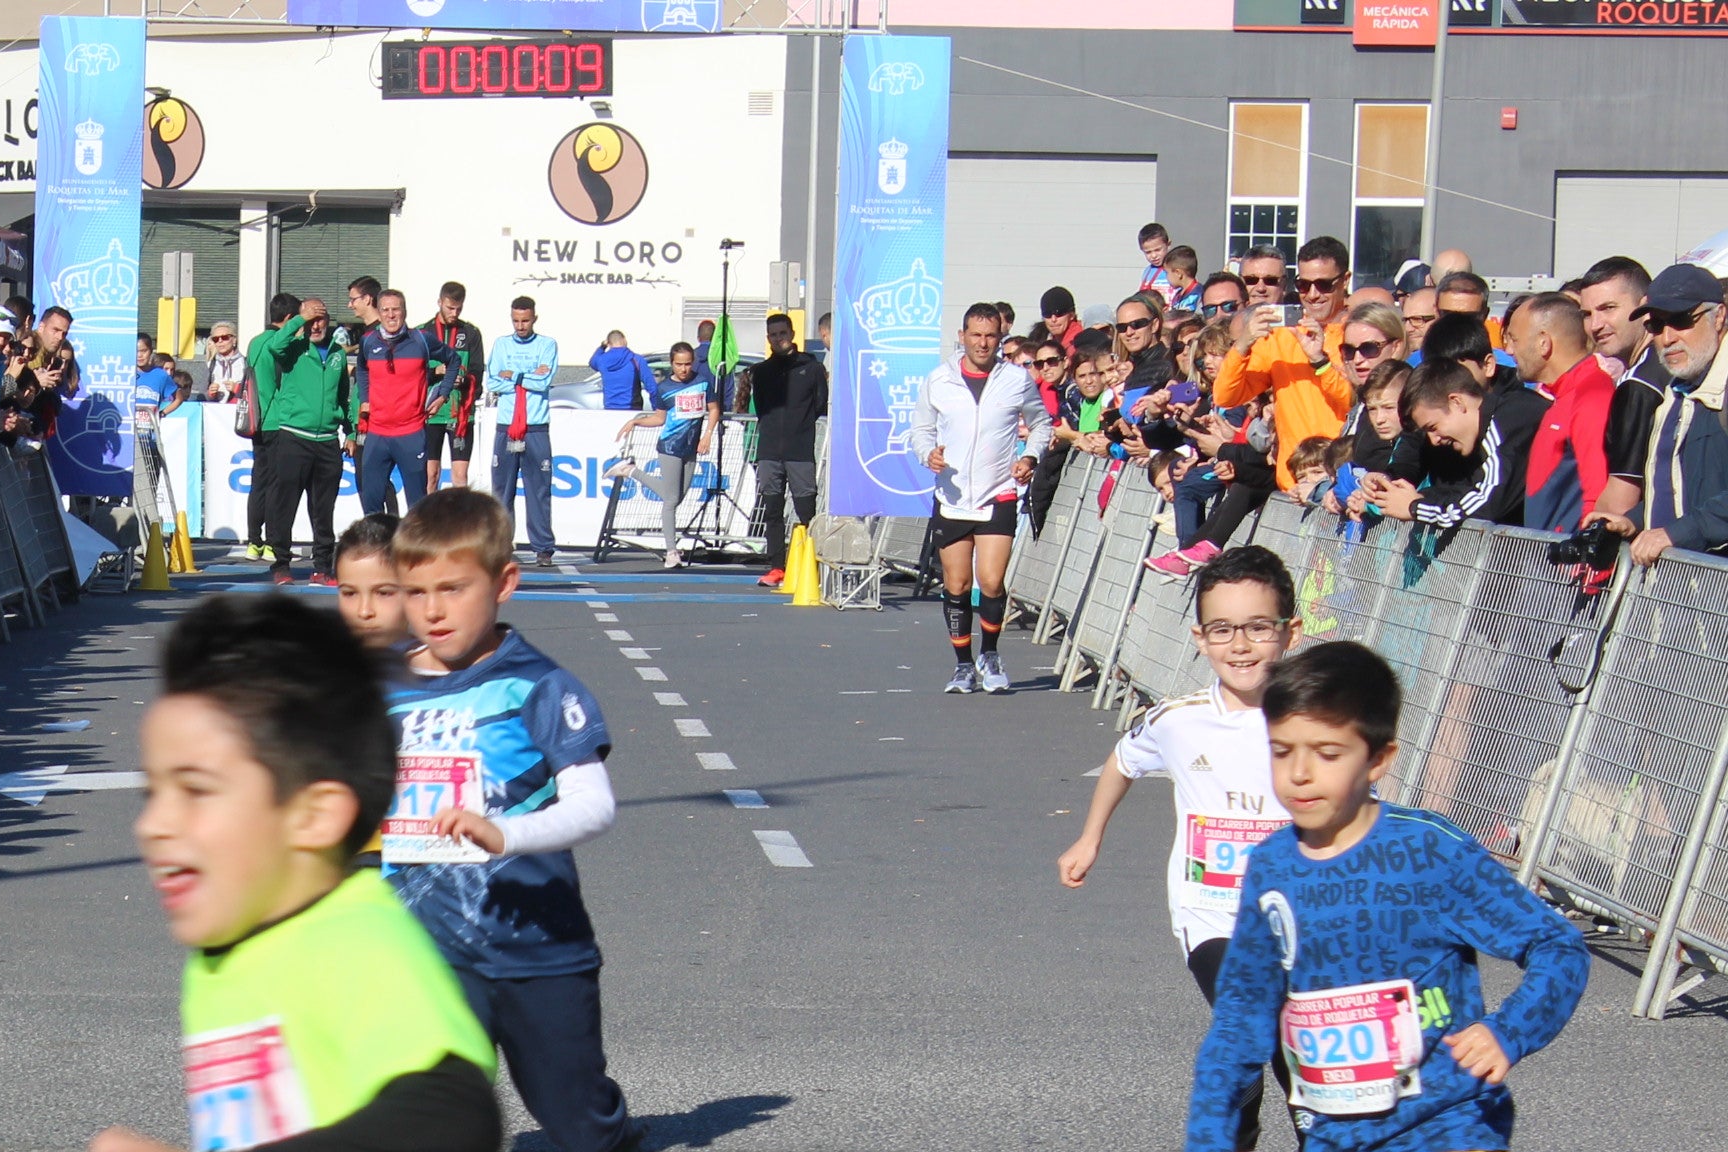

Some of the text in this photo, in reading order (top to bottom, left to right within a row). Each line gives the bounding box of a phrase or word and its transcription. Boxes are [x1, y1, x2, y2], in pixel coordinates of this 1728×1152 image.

[1363, 6, 1429, 17] MECÁNICA
[1372, 18, 1419, 29] RÁPIDA
[4, 98, 38, 146] LO
[17, 160, 37, 181] BA
[512, 239, 683, 267] NEW LORO
[559, 273, 633, 284] SNACK BAR
[1226, 791, 1264, 815] Fly
[1217, 820, 1254, 829] CARRERA
[1204, 829, 1232, 839] CIUDAD
[1234, 831, 1244, 840] DE
[1295, 881, 1368, 910] HARDER
[1333, 993, 1379, 1009] POPULAR
[1310, 1014, 1322, 1025] DE
[1324, 1007, 1377, 1023] ROQUETAS
[1299, 1024, 1375, 1064] 920
